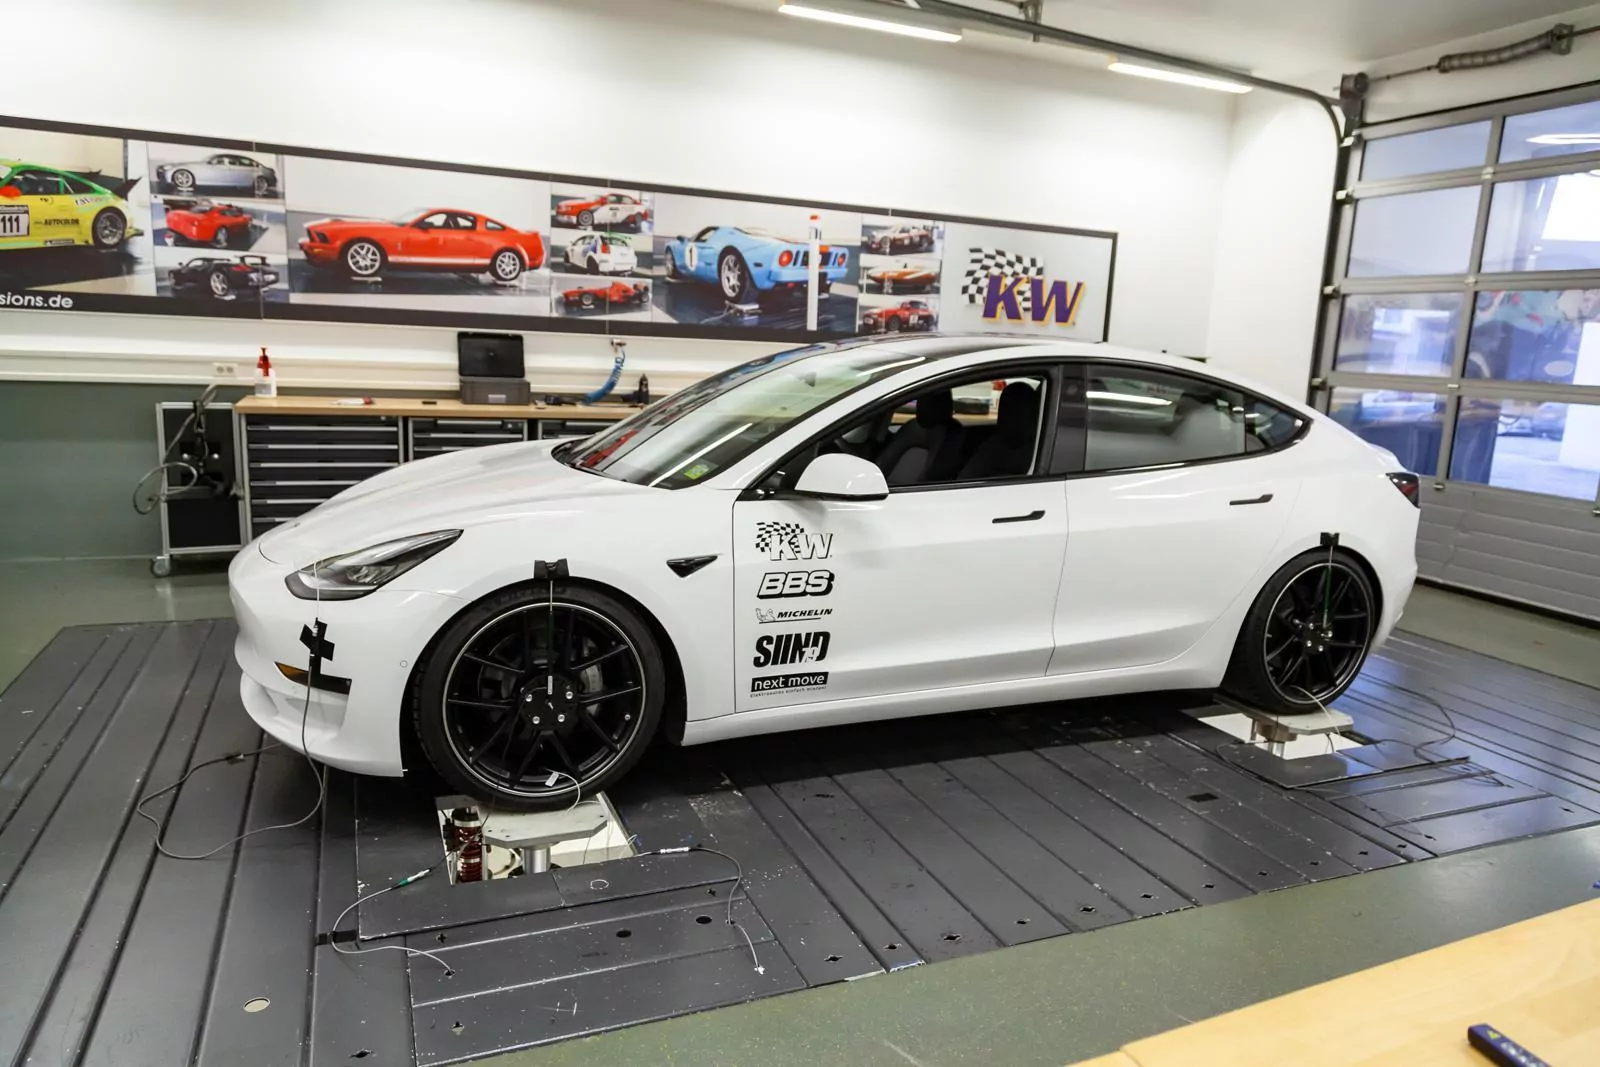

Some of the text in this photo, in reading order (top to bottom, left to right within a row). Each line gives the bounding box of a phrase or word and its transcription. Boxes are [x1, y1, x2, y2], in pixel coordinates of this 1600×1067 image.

[0, 292, 73, 308] sions.de
[982, 273, 1086, 326] KW
[770, 533, 833, 561] KW
[757, 570, 835, 599] BBS
[777, 608, 832, 619] MICHELIN
[754, 675, 824, 690] next move
